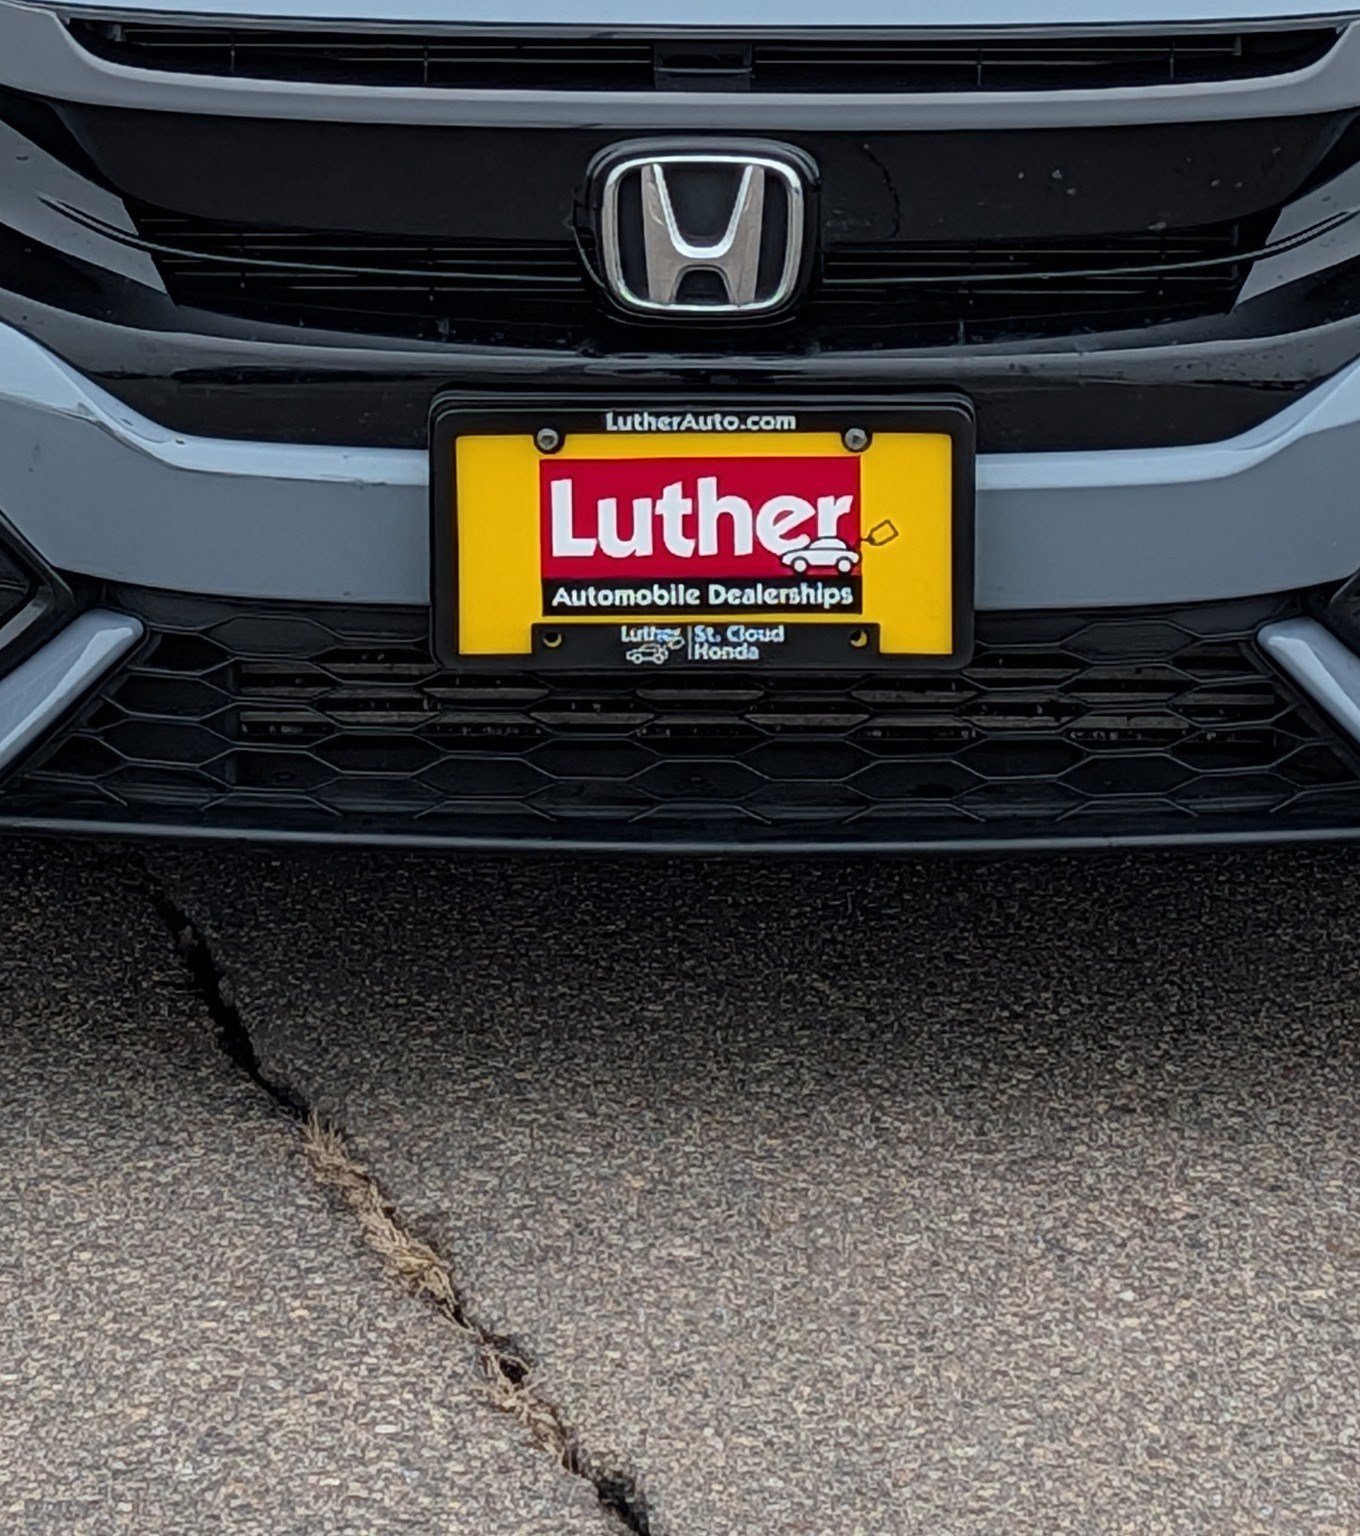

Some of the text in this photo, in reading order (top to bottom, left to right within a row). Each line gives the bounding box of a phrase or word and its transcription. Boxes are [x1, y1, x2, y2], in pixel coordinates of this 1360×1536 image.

[605, 411, 796, 432] LutherAuto.com
[550, 476, 854, 558] Luther
[551, 582, 854, 609] Automobile Dealerships
[726, 624, 785, 643] Cloud
[694, 642, 760, 660] Honda
